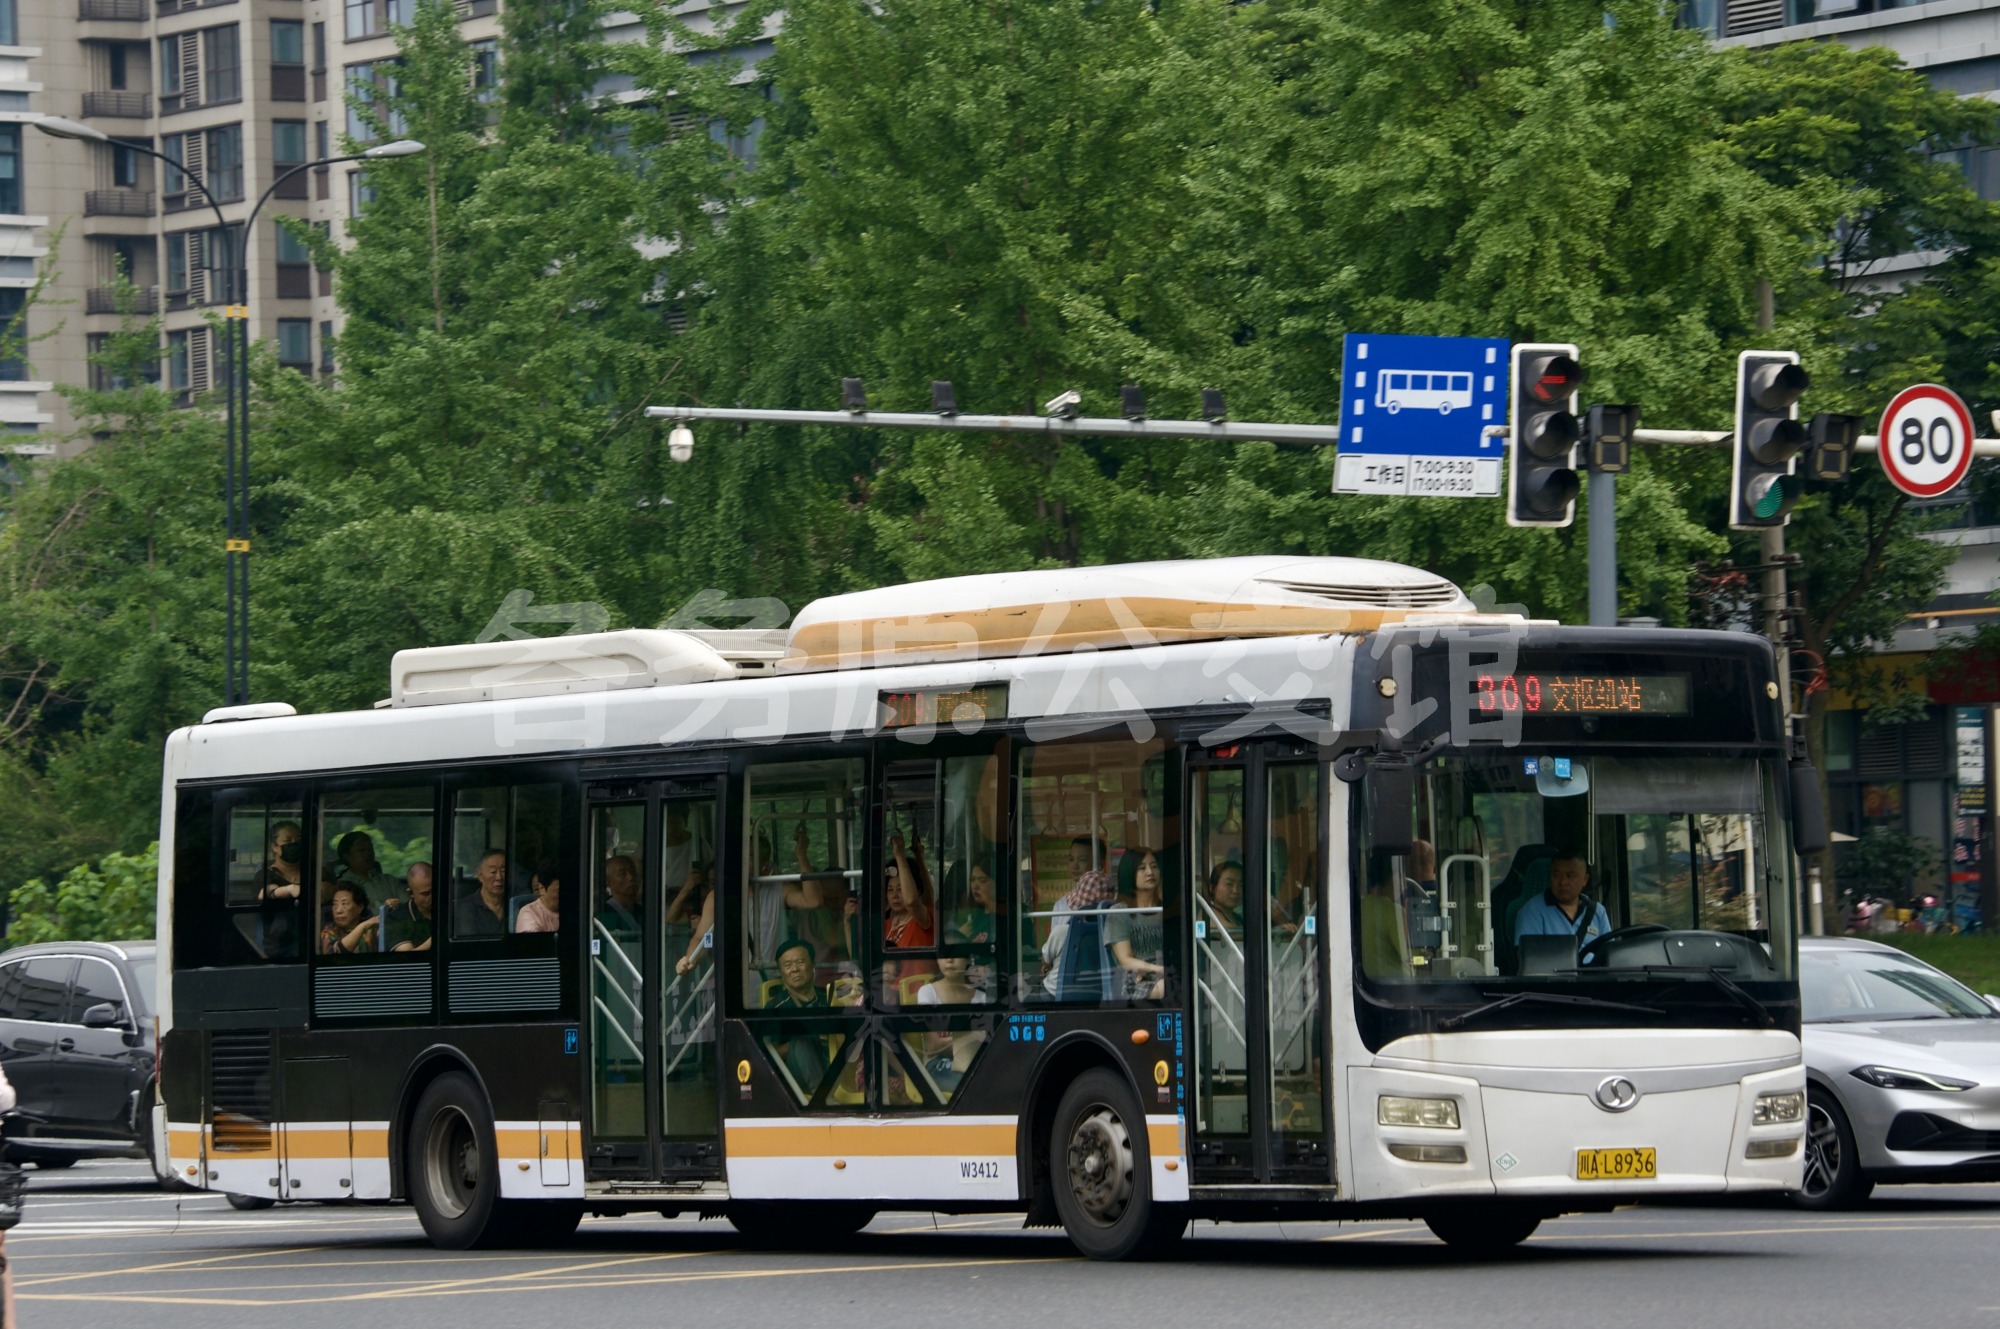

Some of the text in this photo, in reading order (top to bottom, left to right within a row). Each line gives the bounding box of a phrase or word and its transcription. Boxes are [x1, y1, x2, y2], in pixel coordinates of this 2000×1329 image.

[1901, 417, 1953, 465] 80
[1364, 464, 1405, 485] 工作日
[1478, 675, 1541, 711] 309
[960, 1161, 999, 1178] W3412
